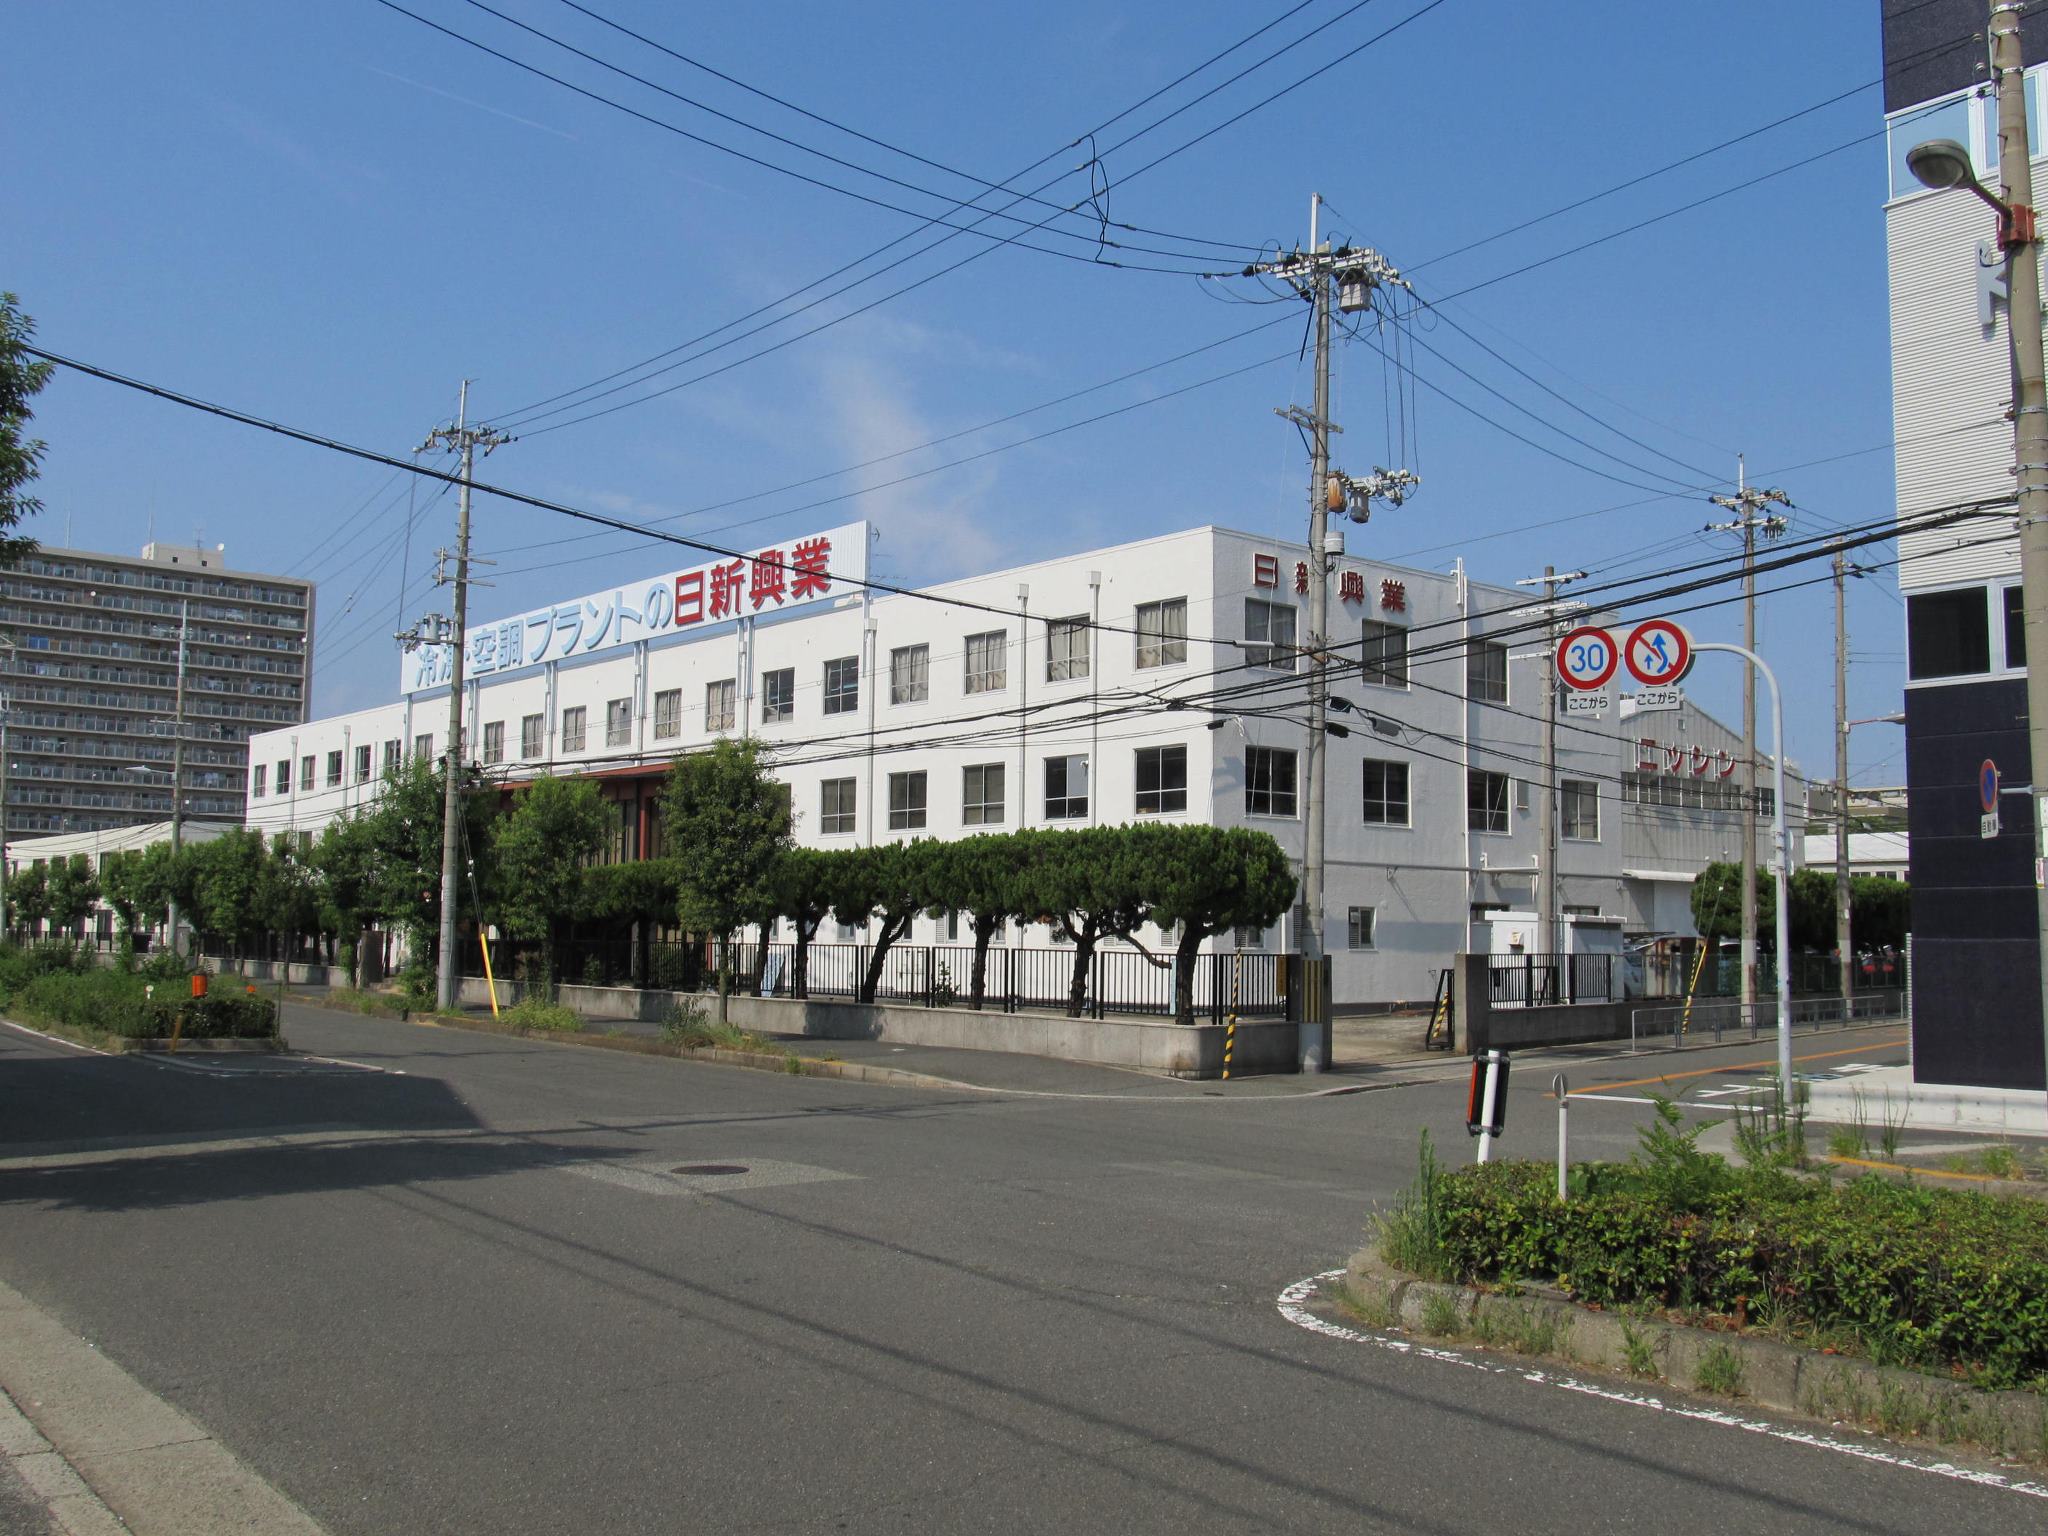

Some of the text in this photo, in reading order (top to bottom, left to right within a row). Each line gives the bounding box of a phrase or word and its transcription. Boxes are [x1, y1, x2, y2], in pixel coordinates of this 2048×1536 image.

[1570, 643, 1604, 673] 30
[1569, 696, 1608, 710] ここから
[1636, 691, 1677, 706] ここから
